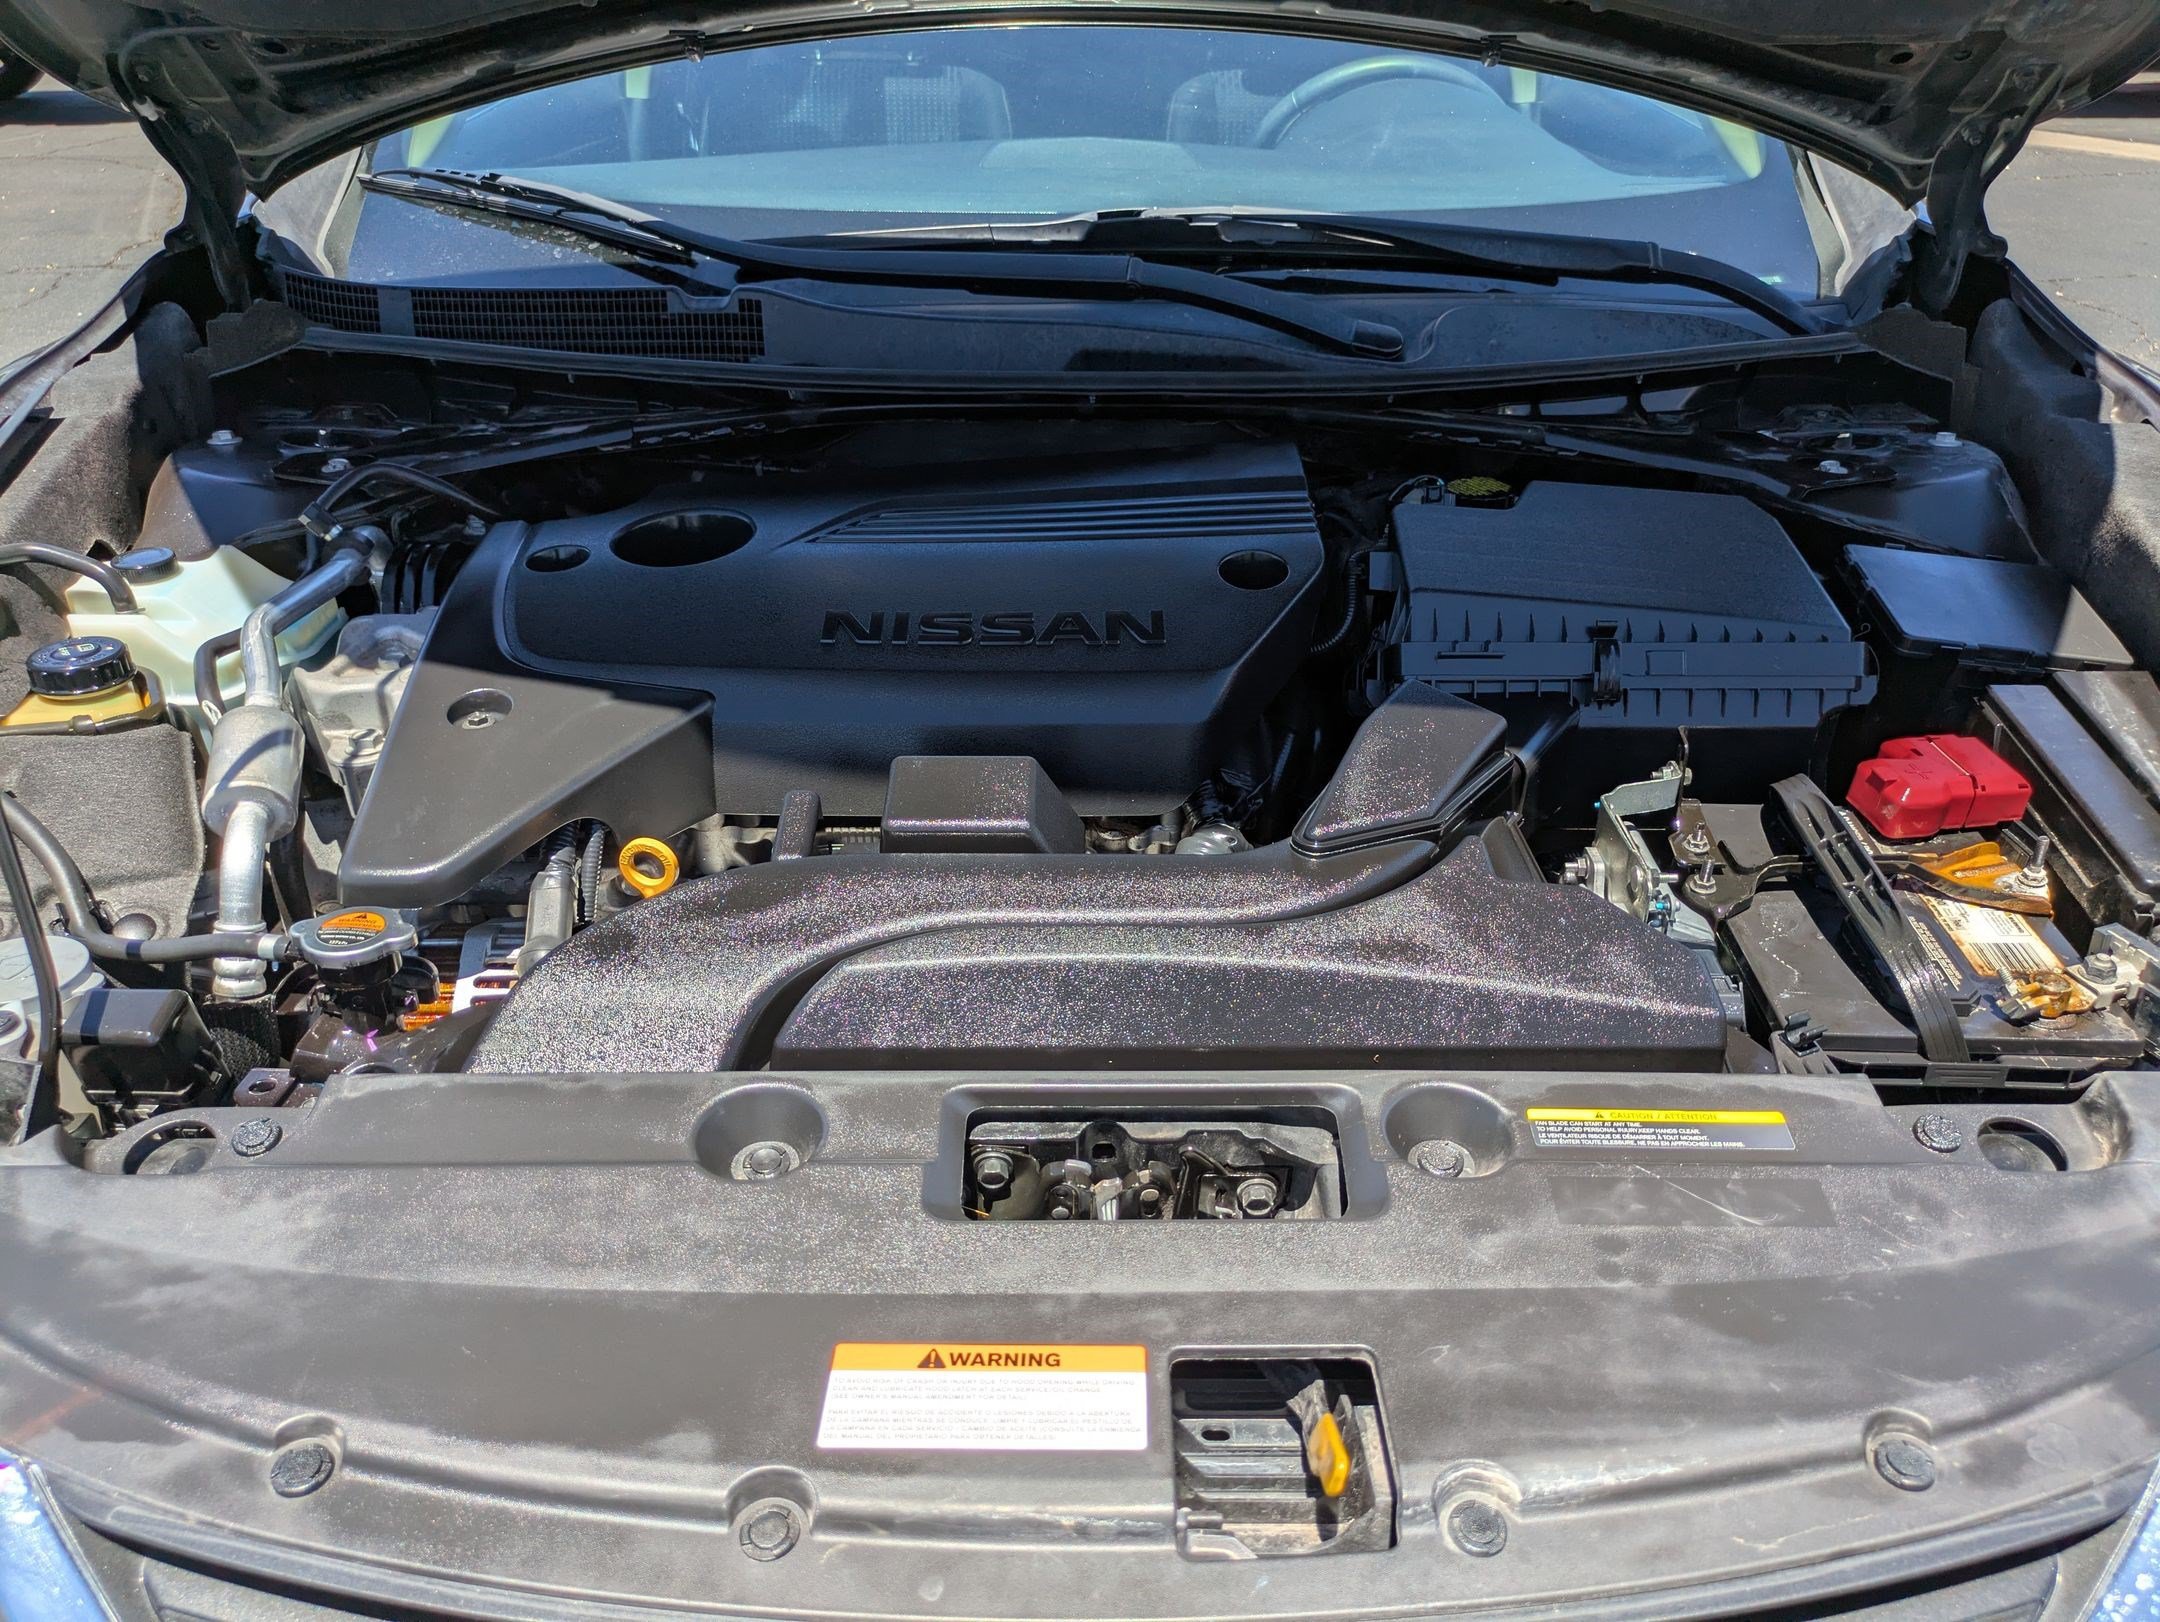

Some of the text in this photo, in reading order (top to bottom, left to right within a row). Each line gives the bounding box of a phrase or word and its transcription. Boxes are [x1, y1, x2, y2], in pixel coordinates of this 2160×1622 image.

[820, 610, 1166, 645] NISSAN
[620, 844, 652, 865] ENGINE
[1610, 1112, 1653, 1120] CAUTION
[1664, 1112, 1718, 1120] ATTENTION
[950, 1352, 1060, 1366] WARNING
